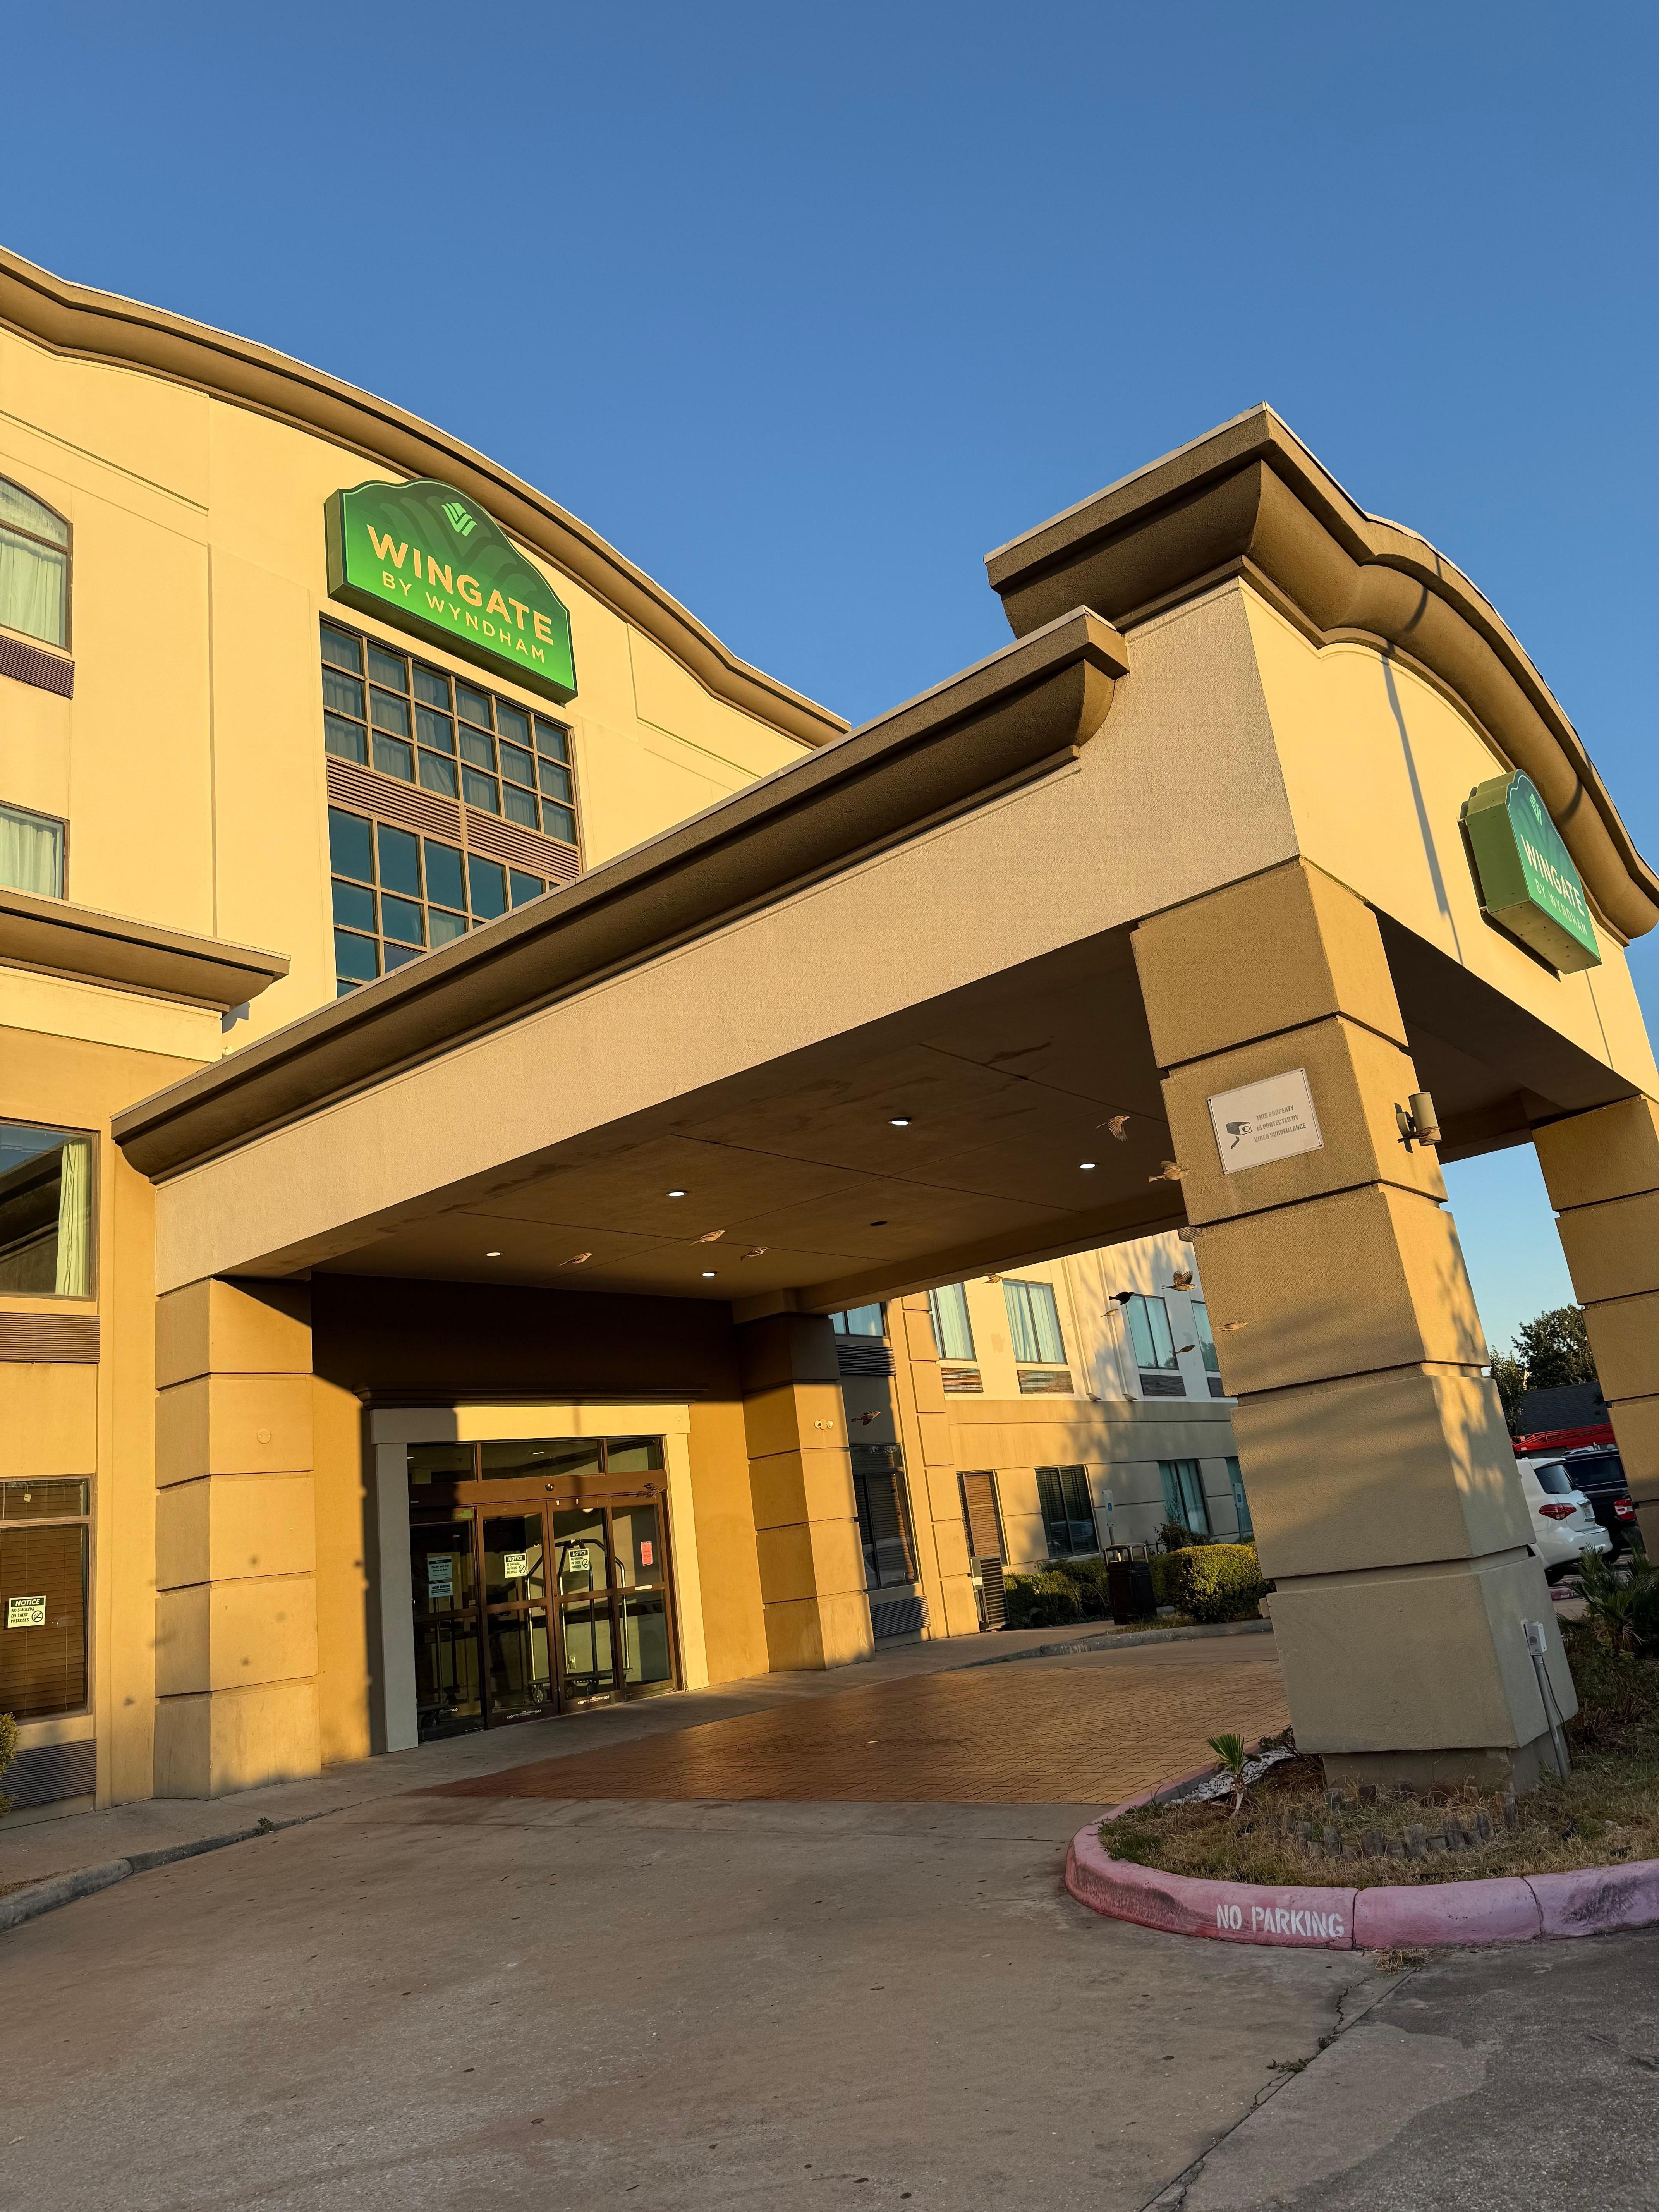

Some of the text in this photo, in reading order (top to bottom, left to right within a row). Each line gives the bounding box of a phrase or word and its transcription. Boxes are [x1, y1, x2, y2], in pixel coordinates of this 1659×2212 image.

[366, 524, 554, 646] WINGATE
[383, 570, 544, 663] BY WYNDHAM
[1520, 834, 1585, 917] WINGATE
[1535, 878, 1588, 937] BY WYNDHAM
[1262, 1117, 1291, 1129] PROTECTED
[1268, 1105, 1294, 1117] PROPERTY
[1254, 1133, 1269, 1142] VIDEO
[1217, 1904, 1345, 1938] NO PARKING
